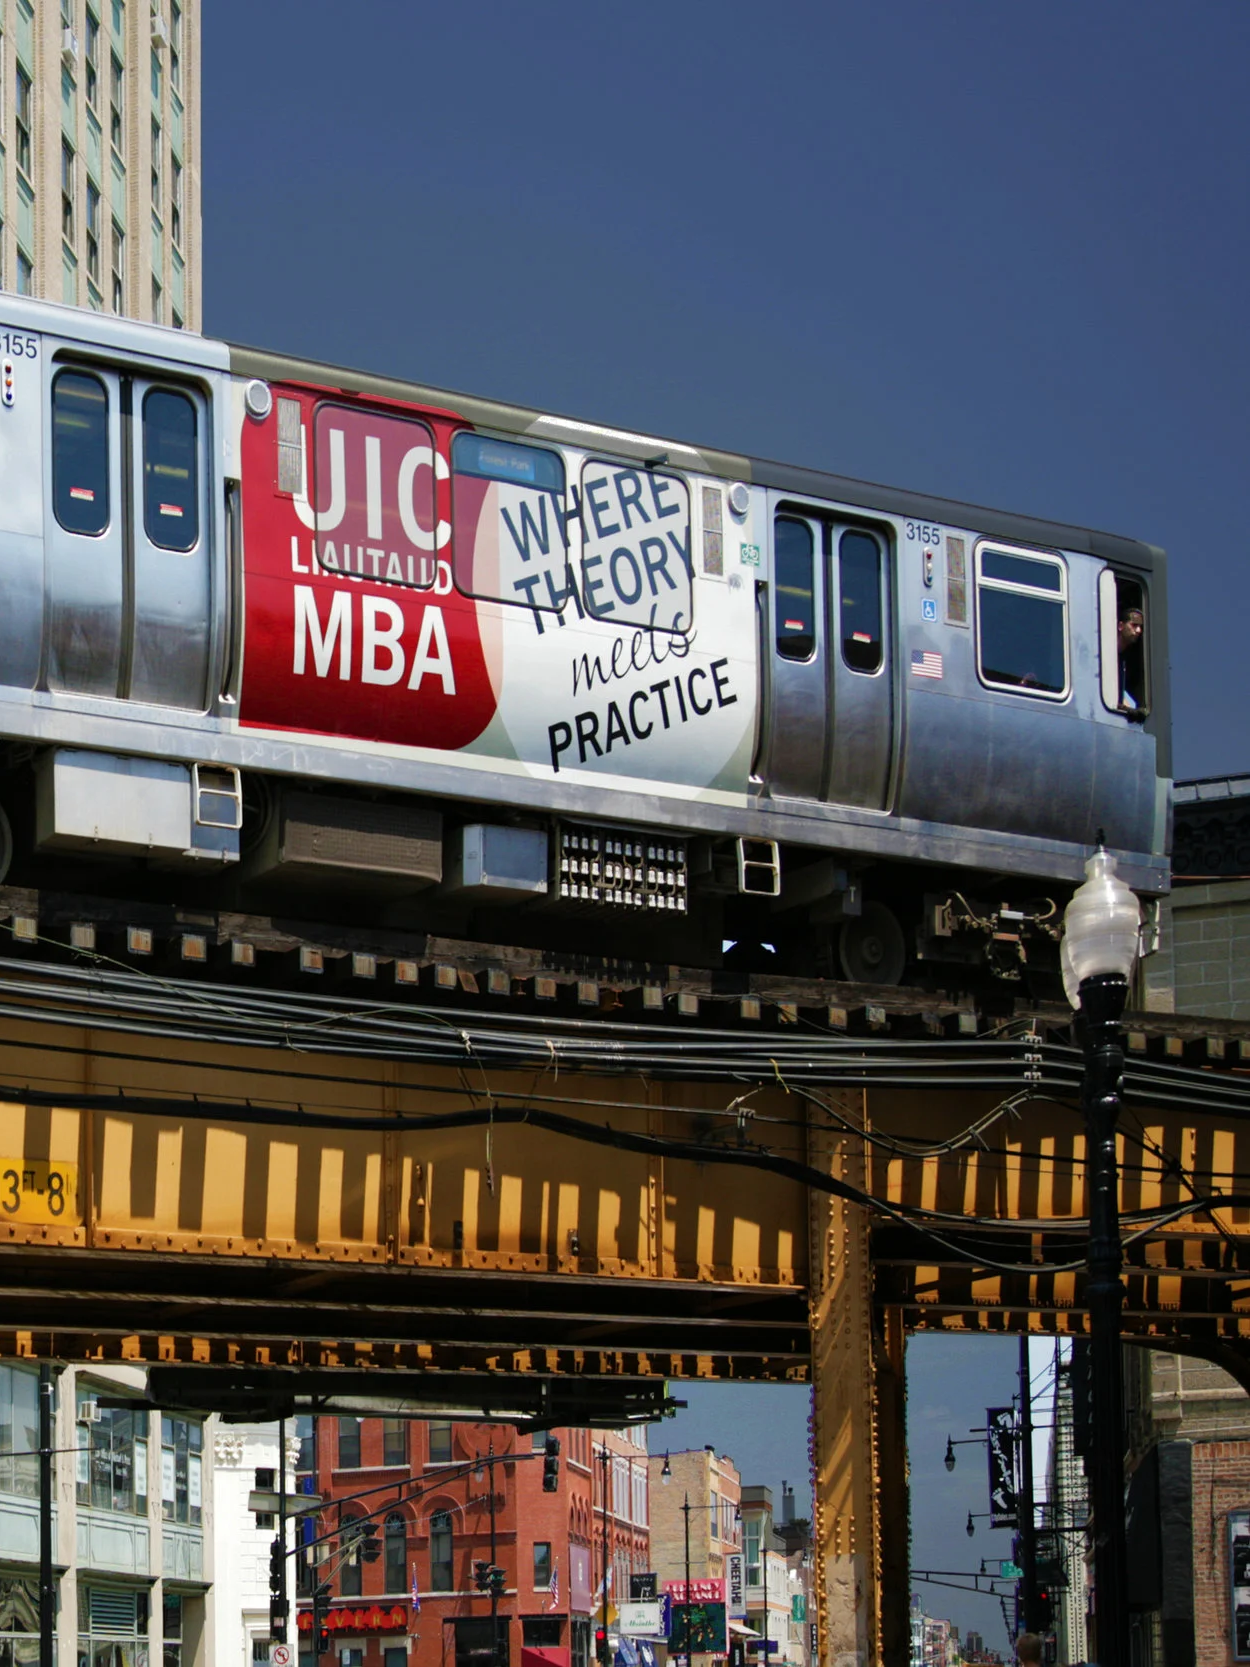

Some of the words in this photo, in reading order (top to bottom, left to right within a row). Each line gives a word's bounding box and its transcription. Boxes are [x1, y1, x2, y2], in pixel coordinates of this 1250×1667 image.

[291, 424, 452, 552] UIC
[500, 468, 680, 563] WHERE
[906, 522, 940, 545] 3155
[290, 535, 453, 596] LIAUTAUD
[513, 525, 695, 635] THEORY
[292, 584, 456, 696] MBA
[573, 603, 697, 697] meets
[548, 657, 737, 774] PRACTICE
[665, 1582, 721, 1592] CURENCY
[730, 1556, 742, 1598] CHEETAH
